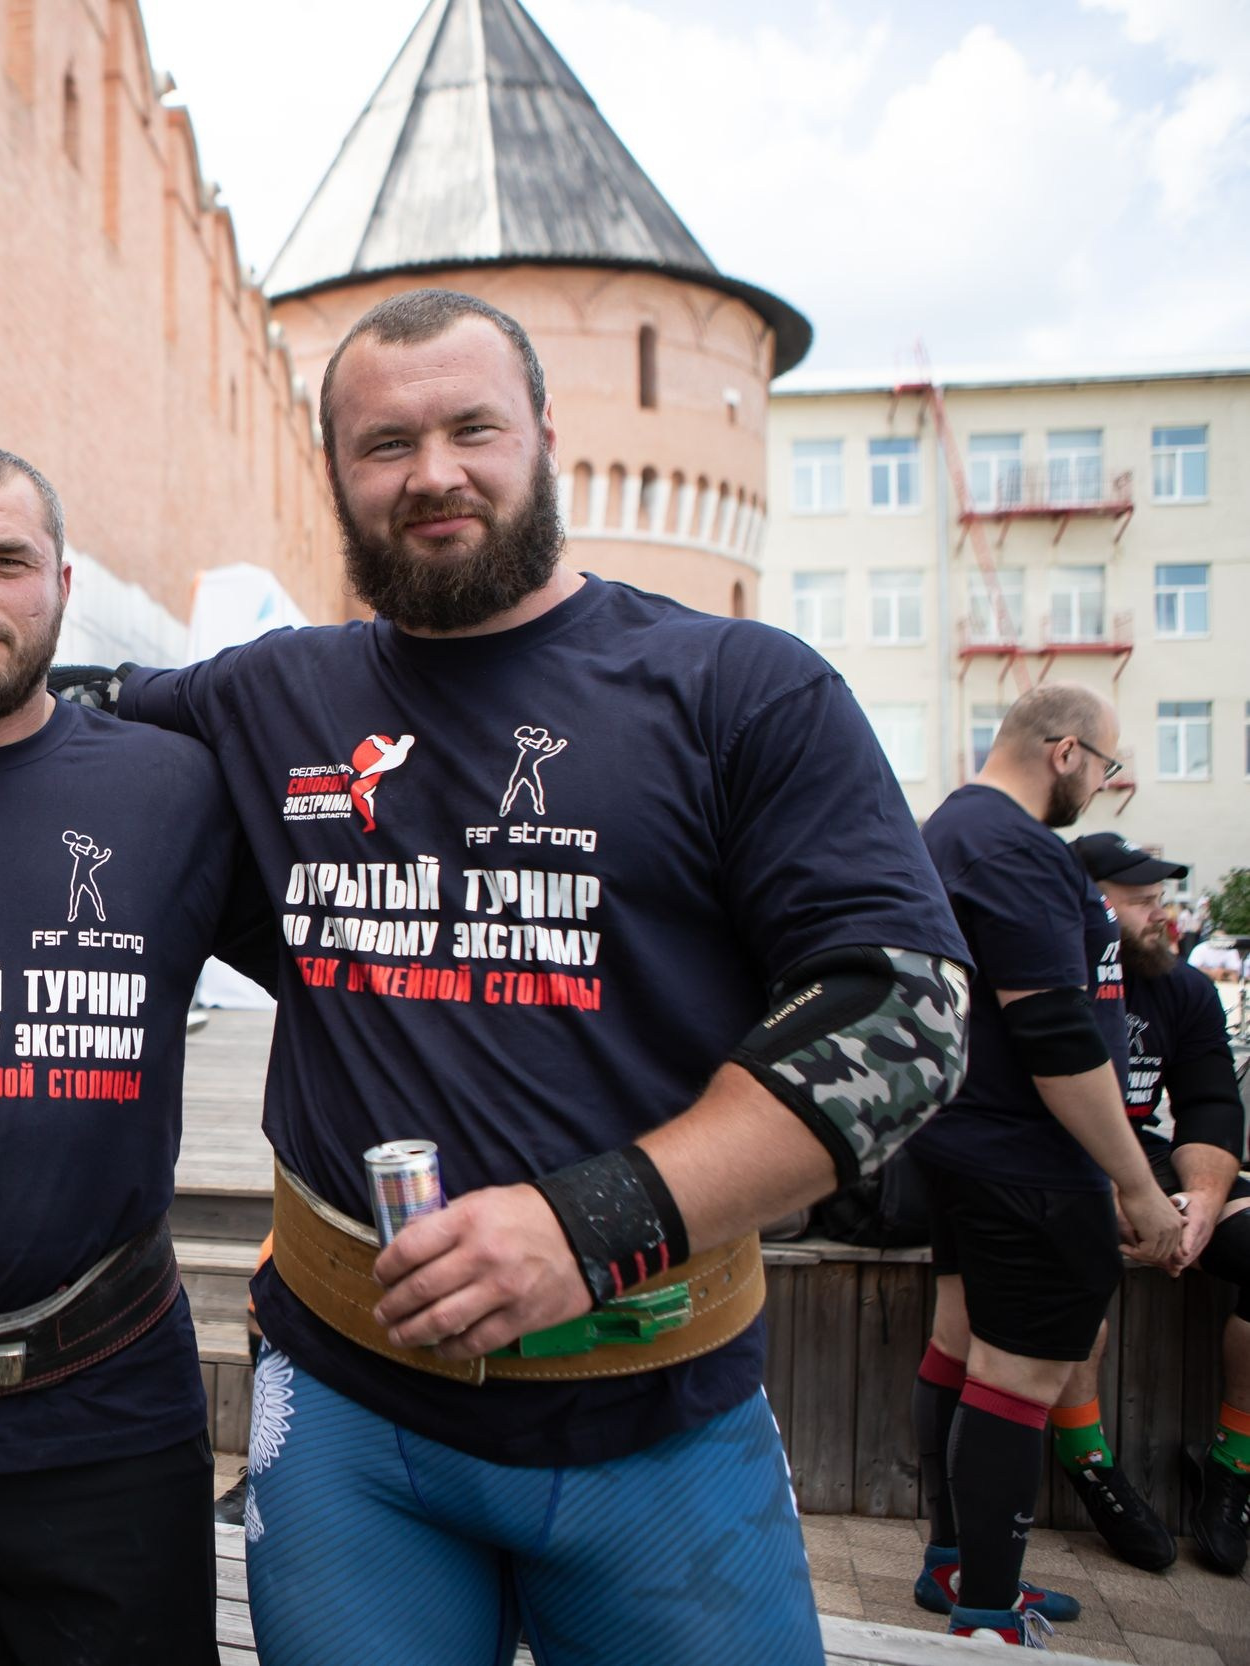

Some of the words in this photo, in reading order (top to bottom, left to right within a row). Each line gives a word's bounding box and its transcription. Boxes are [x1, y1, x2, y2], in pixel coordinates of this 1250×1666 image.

[287, 773, 350, 794] СИЛОВО
[283, 794, 352, 814] ЭКСТРИМА
[508, 821, 597, 852] strong
[285, 854, 440, 910] ОКРЫТЫЙ
[463, 869, 600, 921] ТУРНИР
[78, 928, 144, 954] strong
[452, 922, 600, 966] ЭКСТРИМУ
[23, 969, 147, 1017] ТУРНИР
[295, 955, 340, 987] БОК
[484, 971, 601, 1012] СТОЛИЦЫ
[15, 1024, 144, 1060] ЭКСТРИМУ
[48, 1068, 141, 1104] СТОЛИЦЫ
